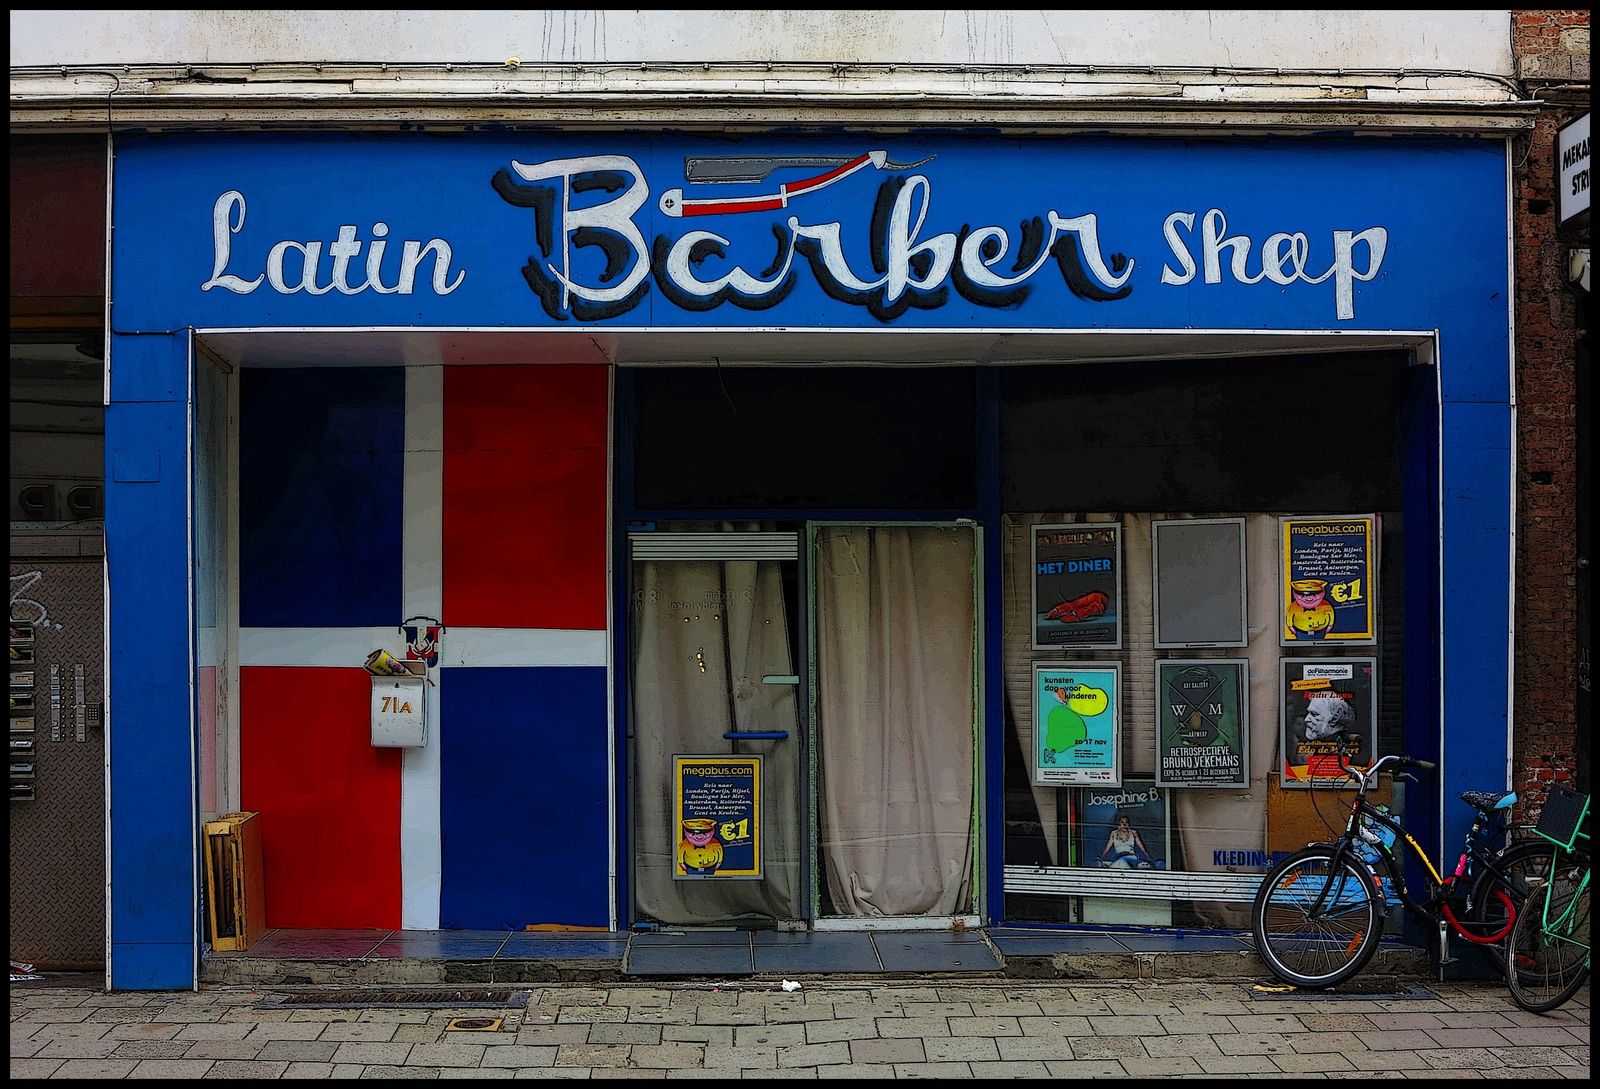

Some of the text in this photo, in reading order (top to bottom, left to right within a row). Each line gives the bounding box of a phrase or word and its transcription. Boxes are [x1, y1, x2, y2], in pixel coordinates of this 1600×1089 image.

[1572, 168, 1590, 196] STRI
[201, 154, 1389, 320] Latin Barber Shop
[1292, 525, 1365, 536] megabus.com
[1037, 559, 1111, 574] HET DINER
[1331, 579, 1363, 602] €1
[382, 696, 412, 714] 71A
[1171, 704, 1223, 716] W M
[1170, 746, 1230, 757] RETROSPECTIEVE
[1163, 755, 1240, 769] BRUNO VEKEMANS
[683, 766, 752, 776] megabus.com
[1088, 790, 1148, 808] Josephine
[720, 818, 750, 841] €1
[1213, 850, 1267, 867] KLEDIN
